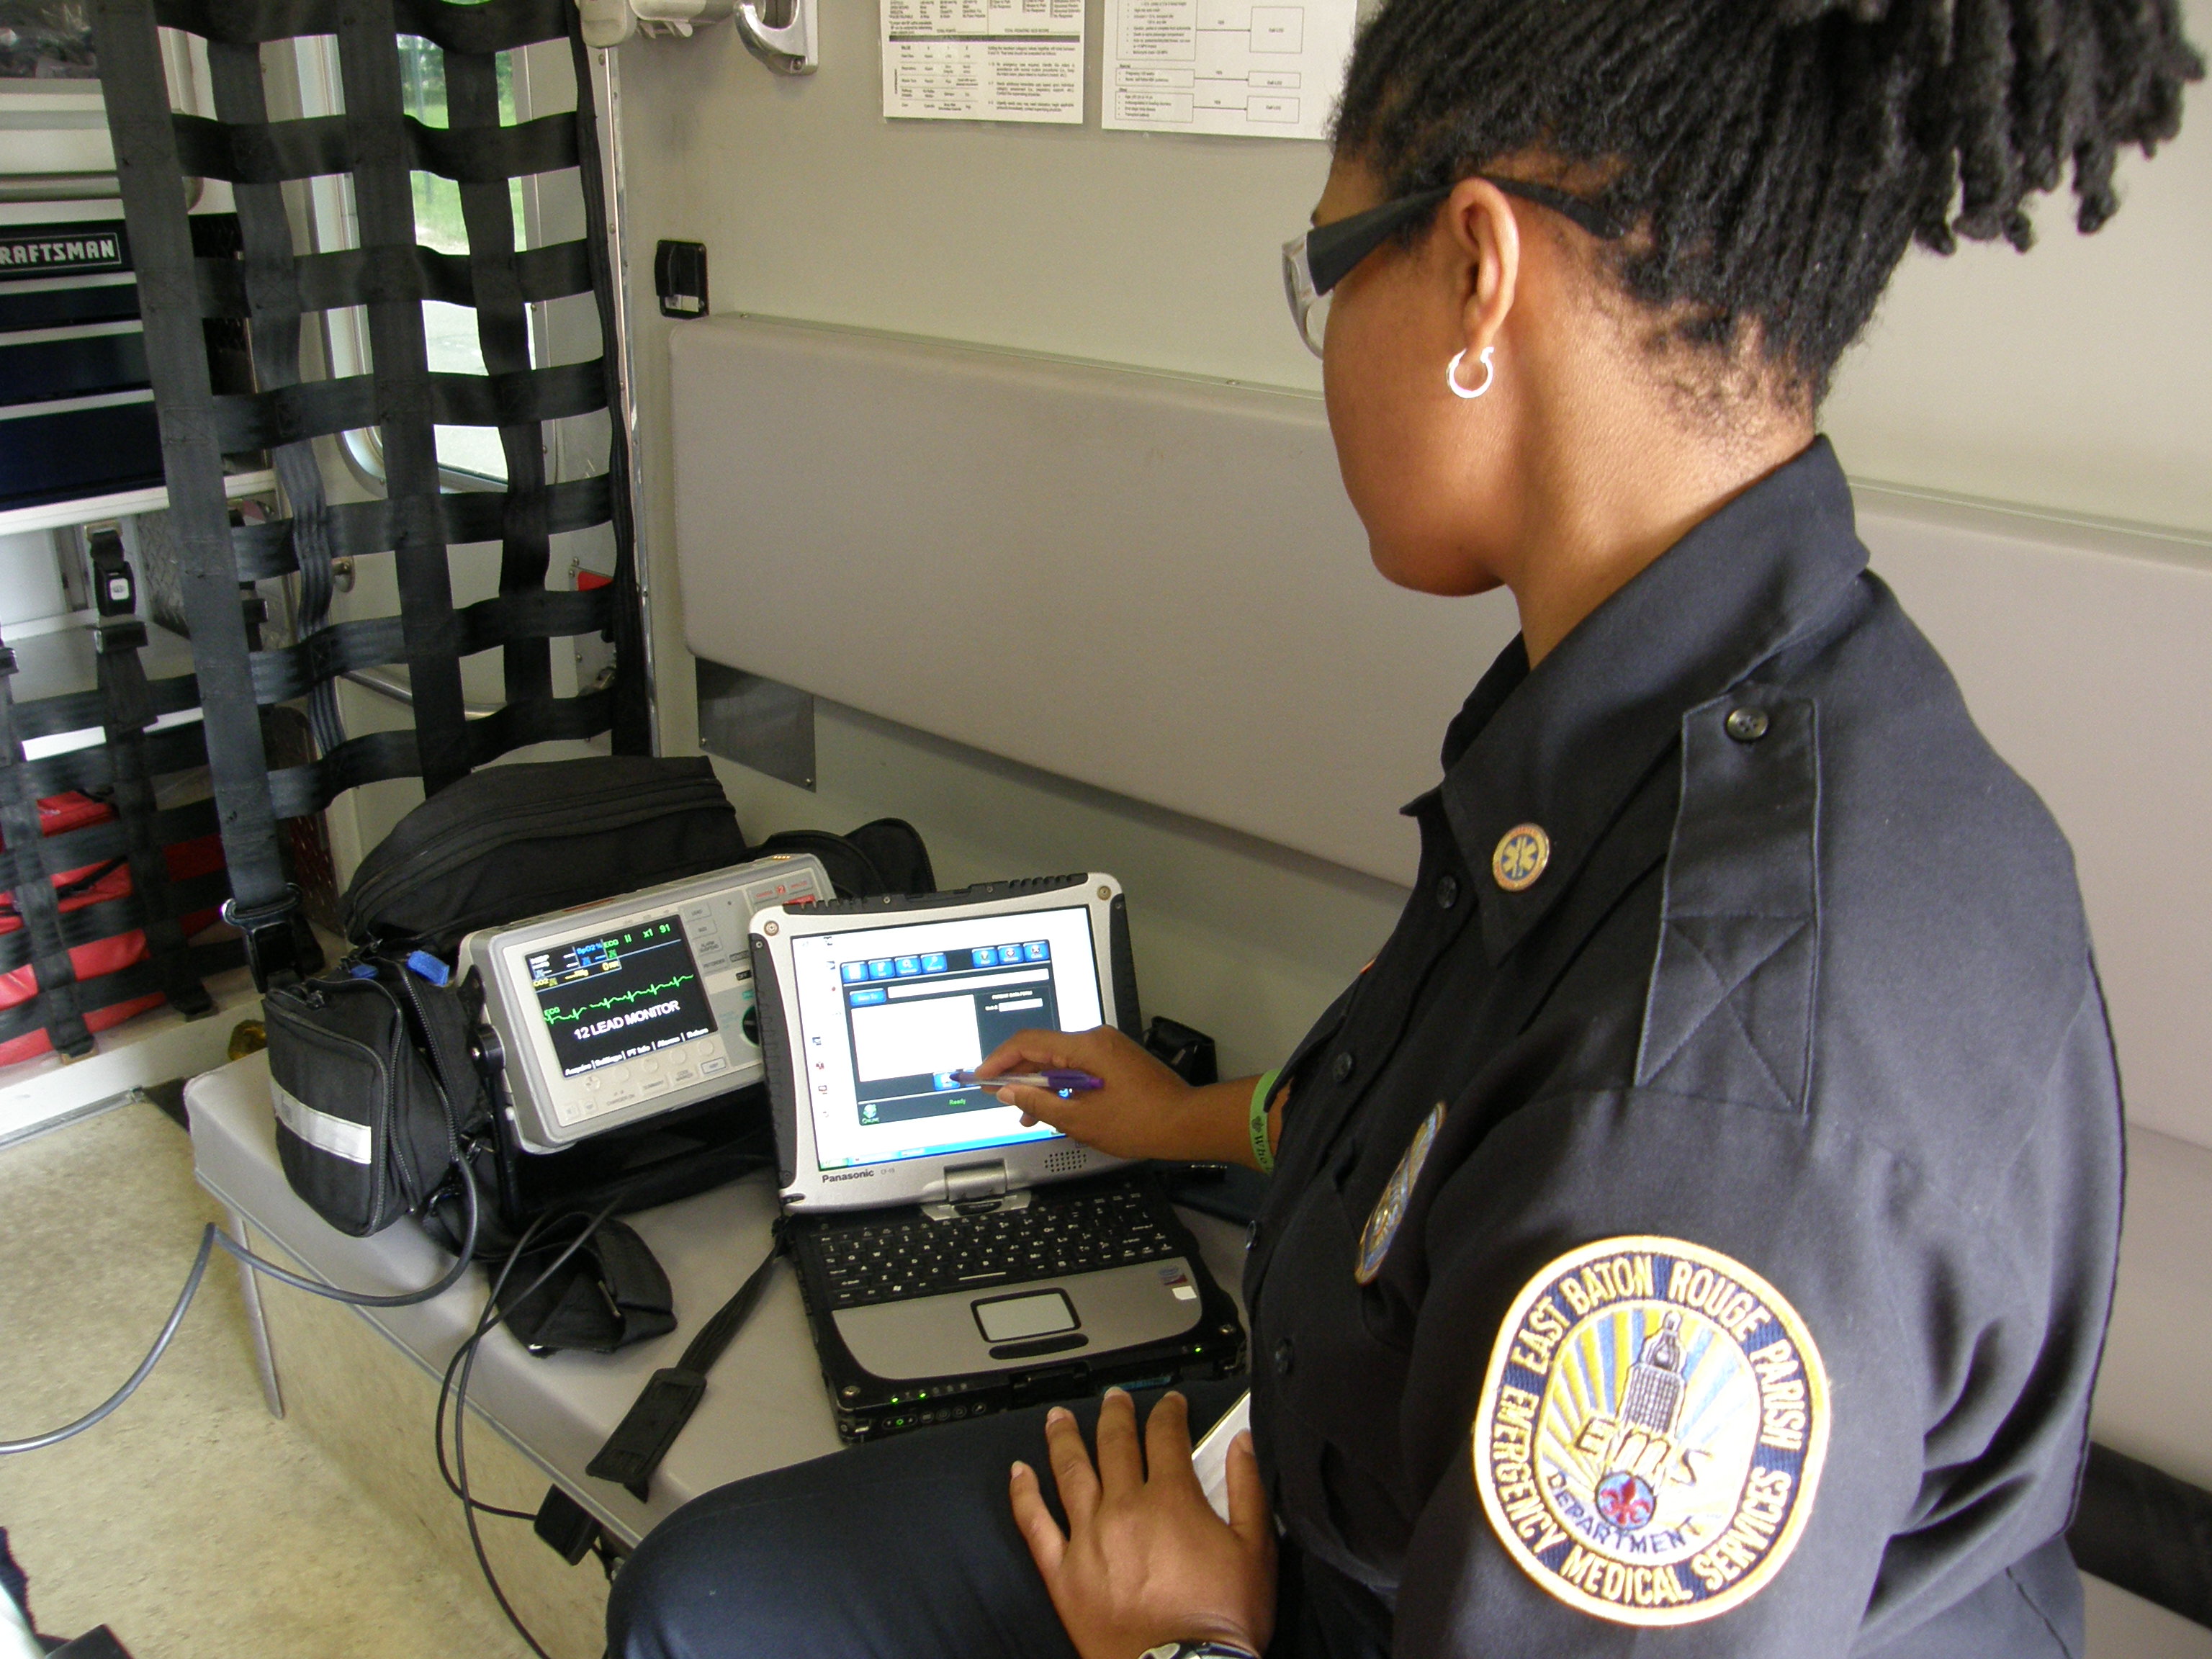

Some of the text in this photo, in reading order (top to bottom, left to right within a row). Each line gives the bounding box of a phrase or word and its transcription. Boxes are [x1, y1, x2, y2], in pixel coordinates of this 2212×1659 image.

[659, 923, 671, 934] 91
[574, 999, 681, 1040] 12 LEAD MONITOR
[822, 1169, 875, 1183] Panasonic
[1511, 1255, 1808, 1450] EAST BATON ROUGE PARISH
[1493, 1386, 1792, 1606] EMERGENCY MEDICAL SERVICES
[1547, 1473, 1704, 1555] DEPARTMENT
